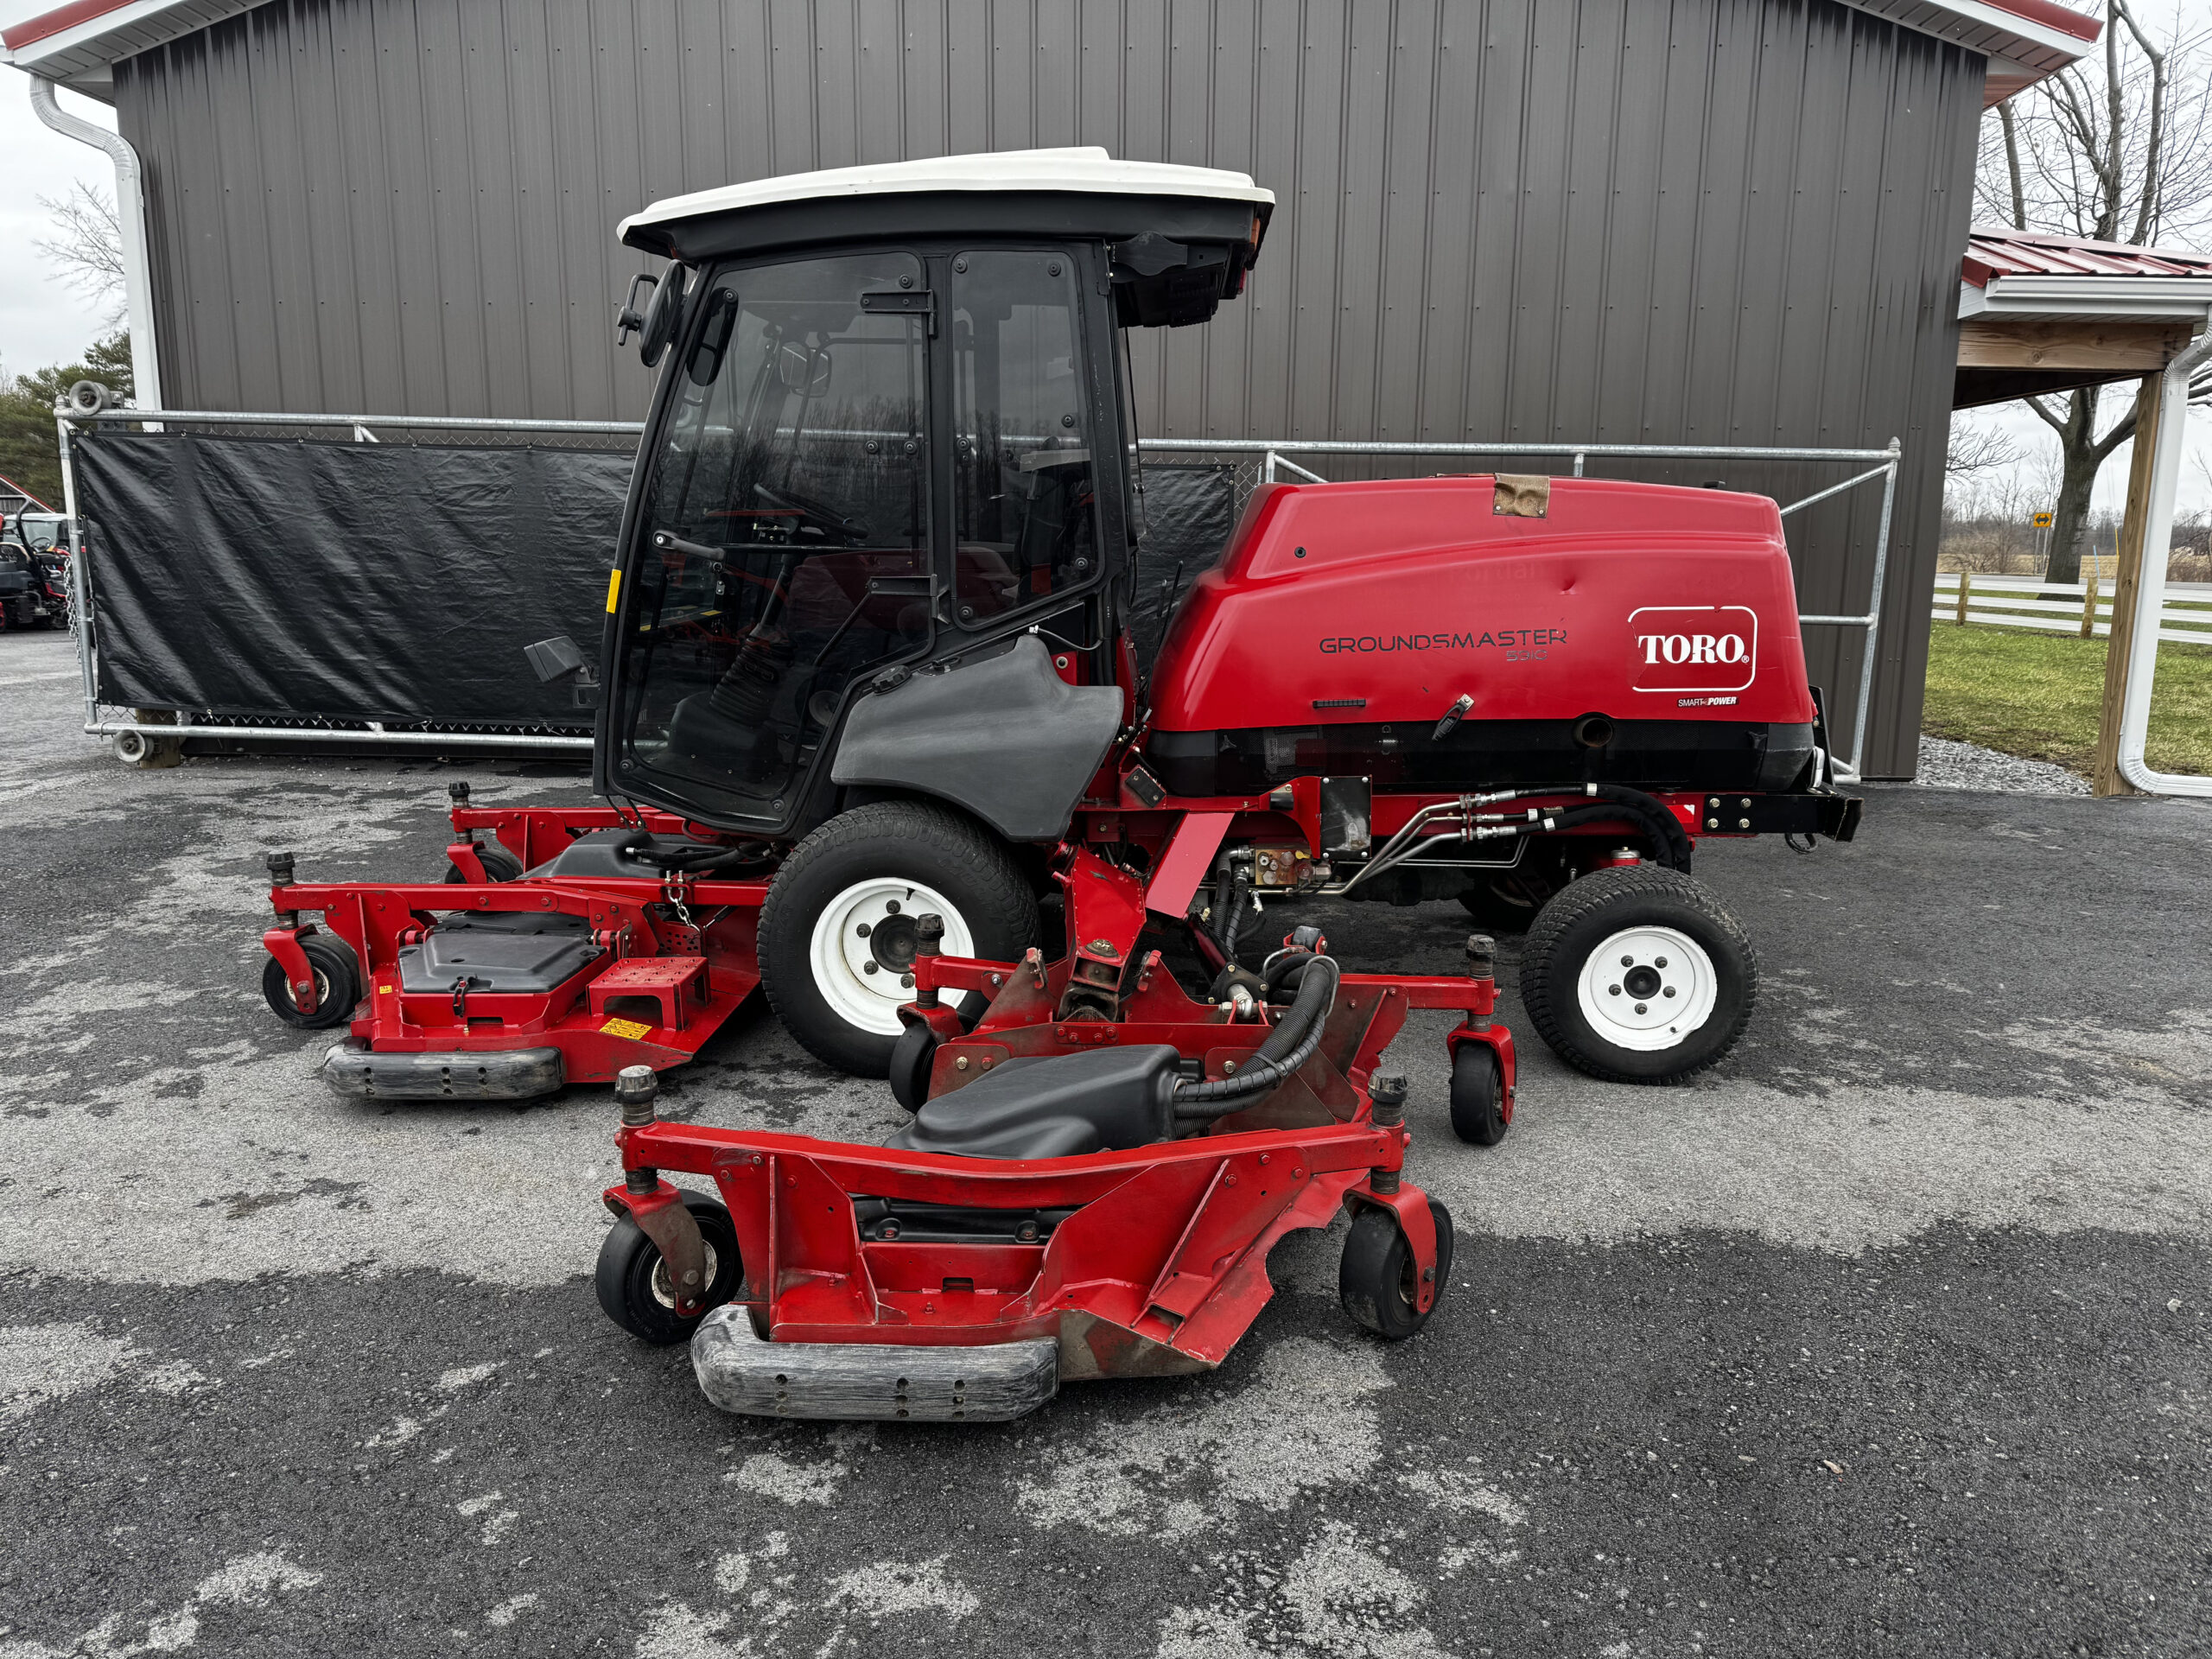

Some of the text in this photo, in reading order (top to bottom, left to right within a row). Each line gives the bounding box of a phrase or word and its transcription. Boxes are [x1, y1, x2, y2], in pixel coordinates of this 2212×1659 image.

[1319, 628, 1567, 654] GROUNDSMASTER
[1638, 633, 1745, 664] TORO
[1707, 696, 1737, 706] POWER
